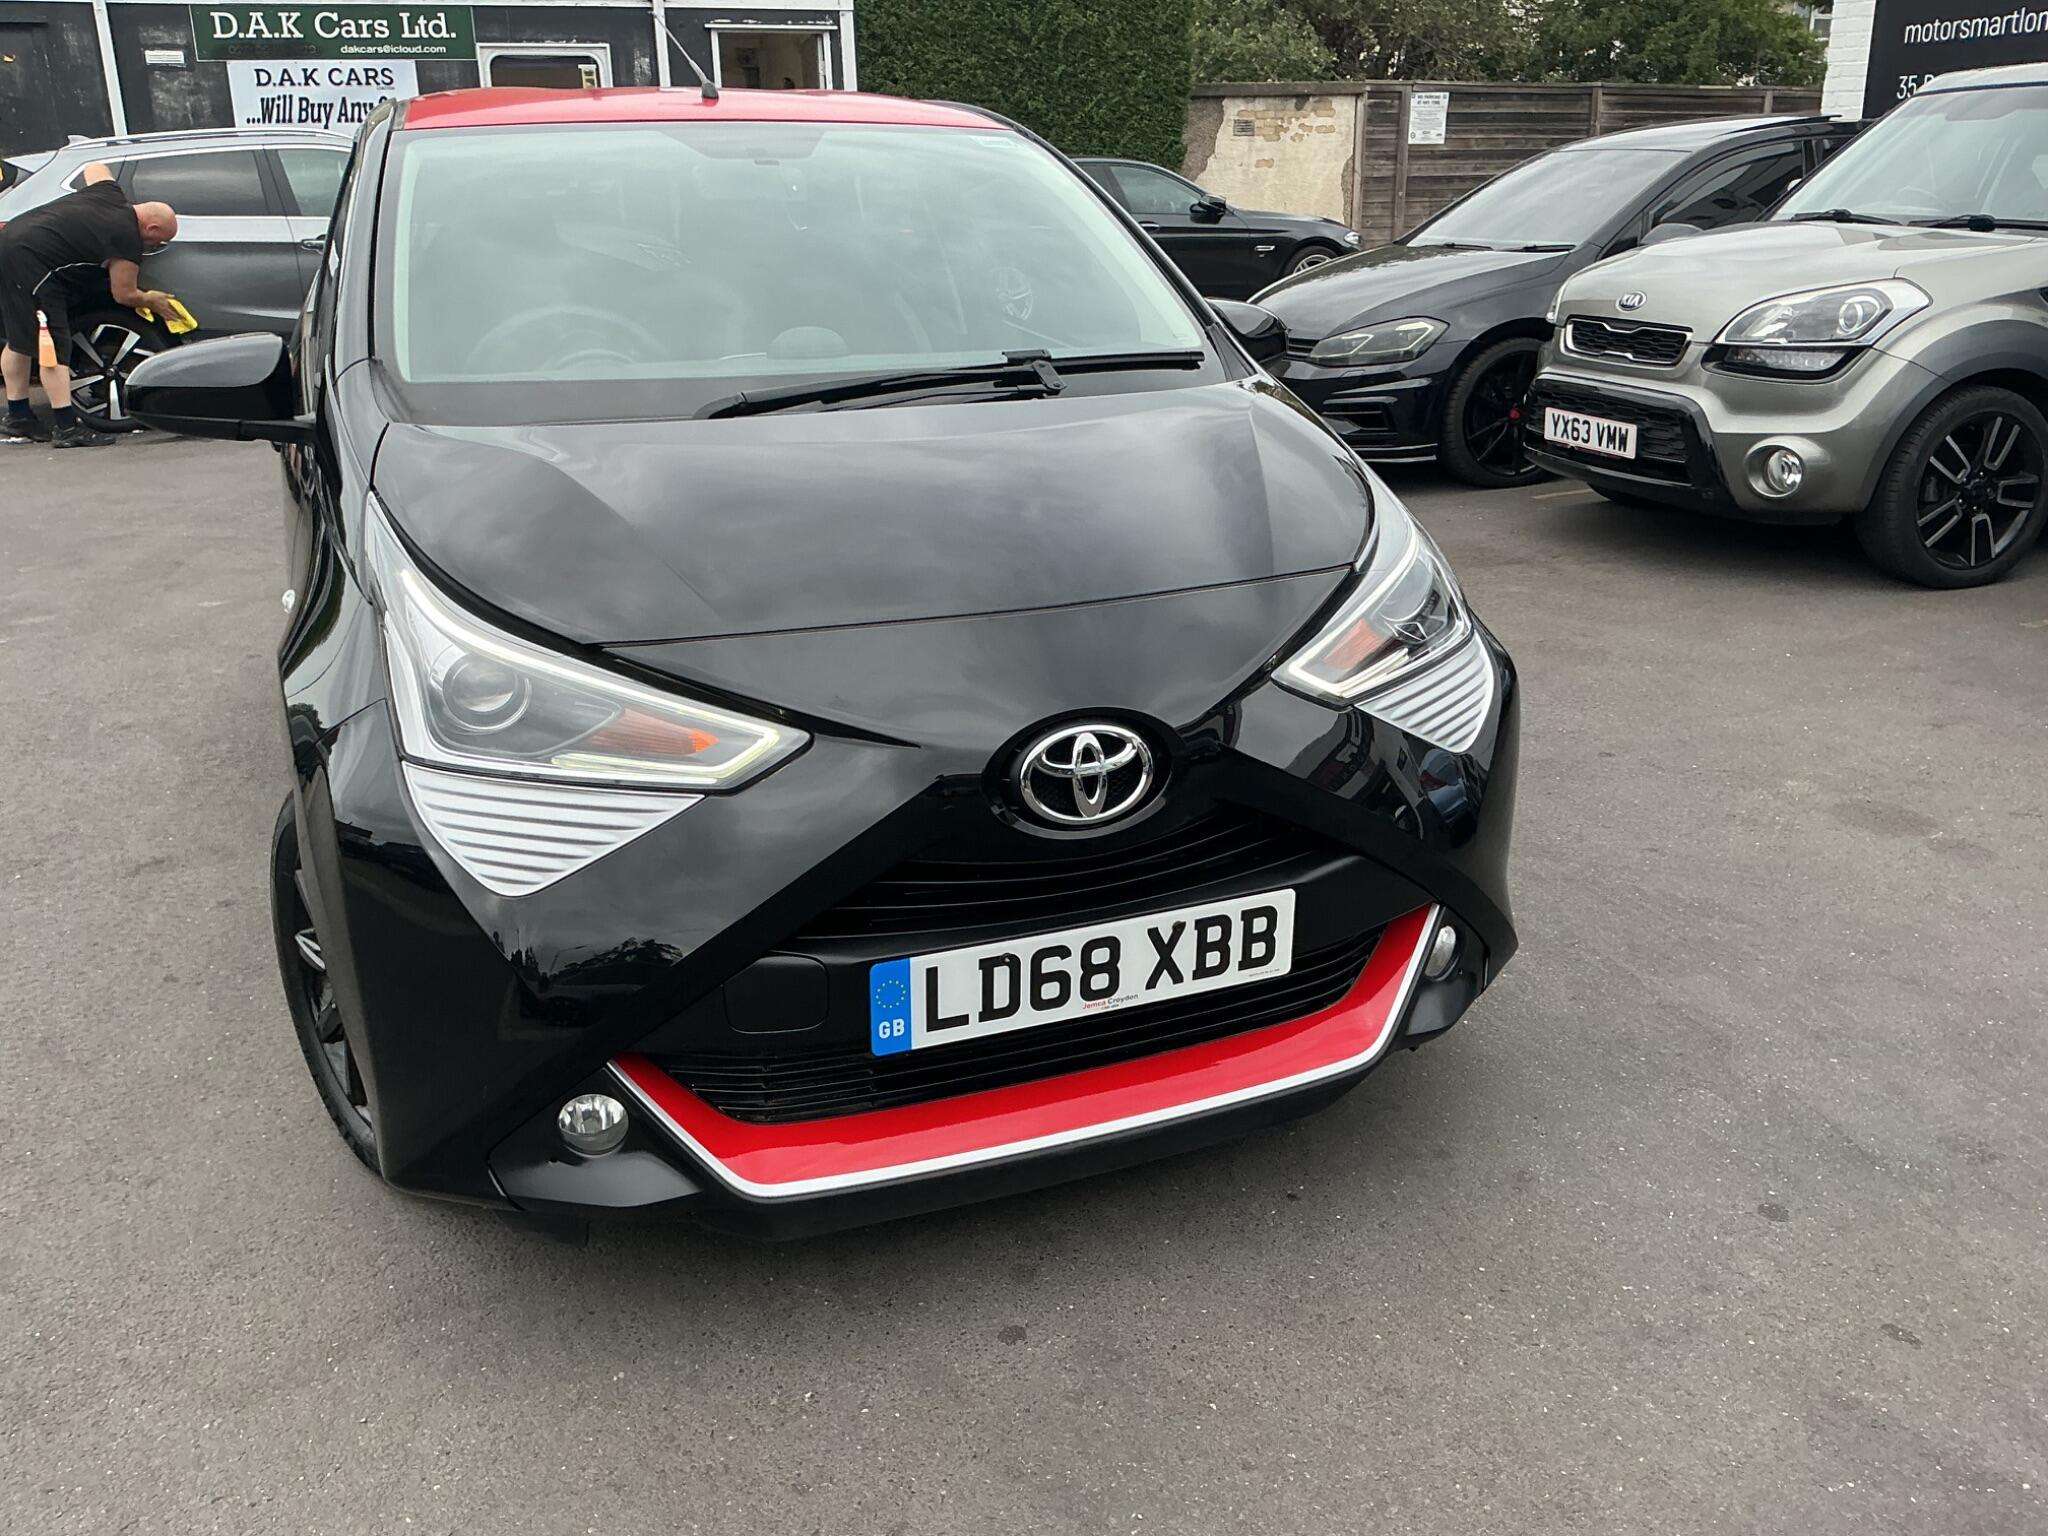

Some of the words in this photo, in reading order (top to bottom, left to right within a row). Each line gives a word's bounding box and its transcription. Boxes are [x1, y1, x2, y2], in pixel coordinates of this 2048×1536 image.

[210, 11, 304, 38] D.A.K
[314, 11, 390, 39] Cars
[399, 12, 457, 38] Ltd.
[1904, 7, 2048, 43] motorsmartlon
[340, 44, 446, 54] dakcars@icloud.com
[254, 68, 320, 87] D.A.K
[328, 67, 394, 87] CARS
[1896, 74, 1918, 99] 35
[298, 97, 334, 129] Buy
[1619, 294, 1641, 307] KIA
[1552, 412, 1592, 444] YX63
[1596, 422, 1629, 453] VMW
[925, 935, 1121, 1033] LD68
[1145, 905, 1278, 991] XBB
[1107, 994, 1139, 1004] Croydon
[878, 1018, 905, 1039] GB
